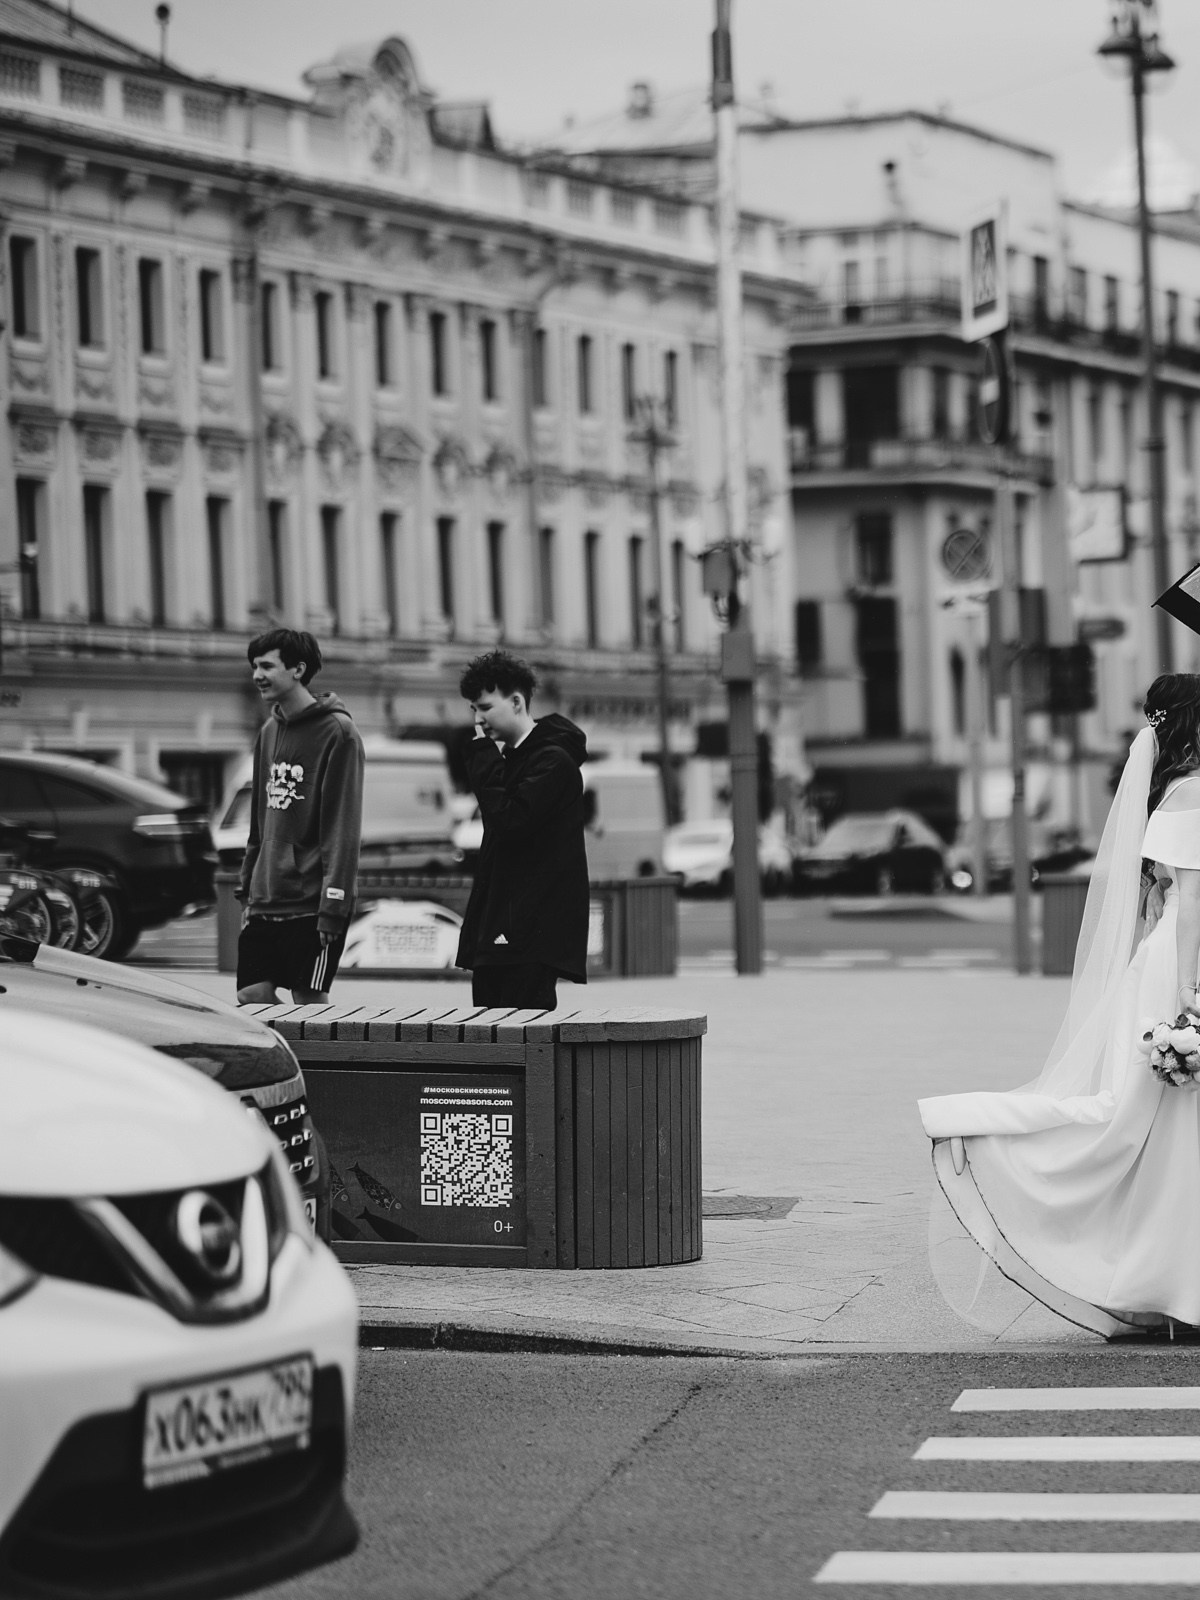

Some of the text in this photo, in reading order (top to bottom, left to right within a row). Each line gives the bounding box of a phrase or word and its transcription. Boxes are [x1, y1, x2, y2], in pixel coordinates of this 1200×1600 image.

[423, 1086, 509, 1095] #московскиесезоны
[420, 1097, 513, 1106] moscowseasons.com
[493, 1220, 514, 1233] 0+
